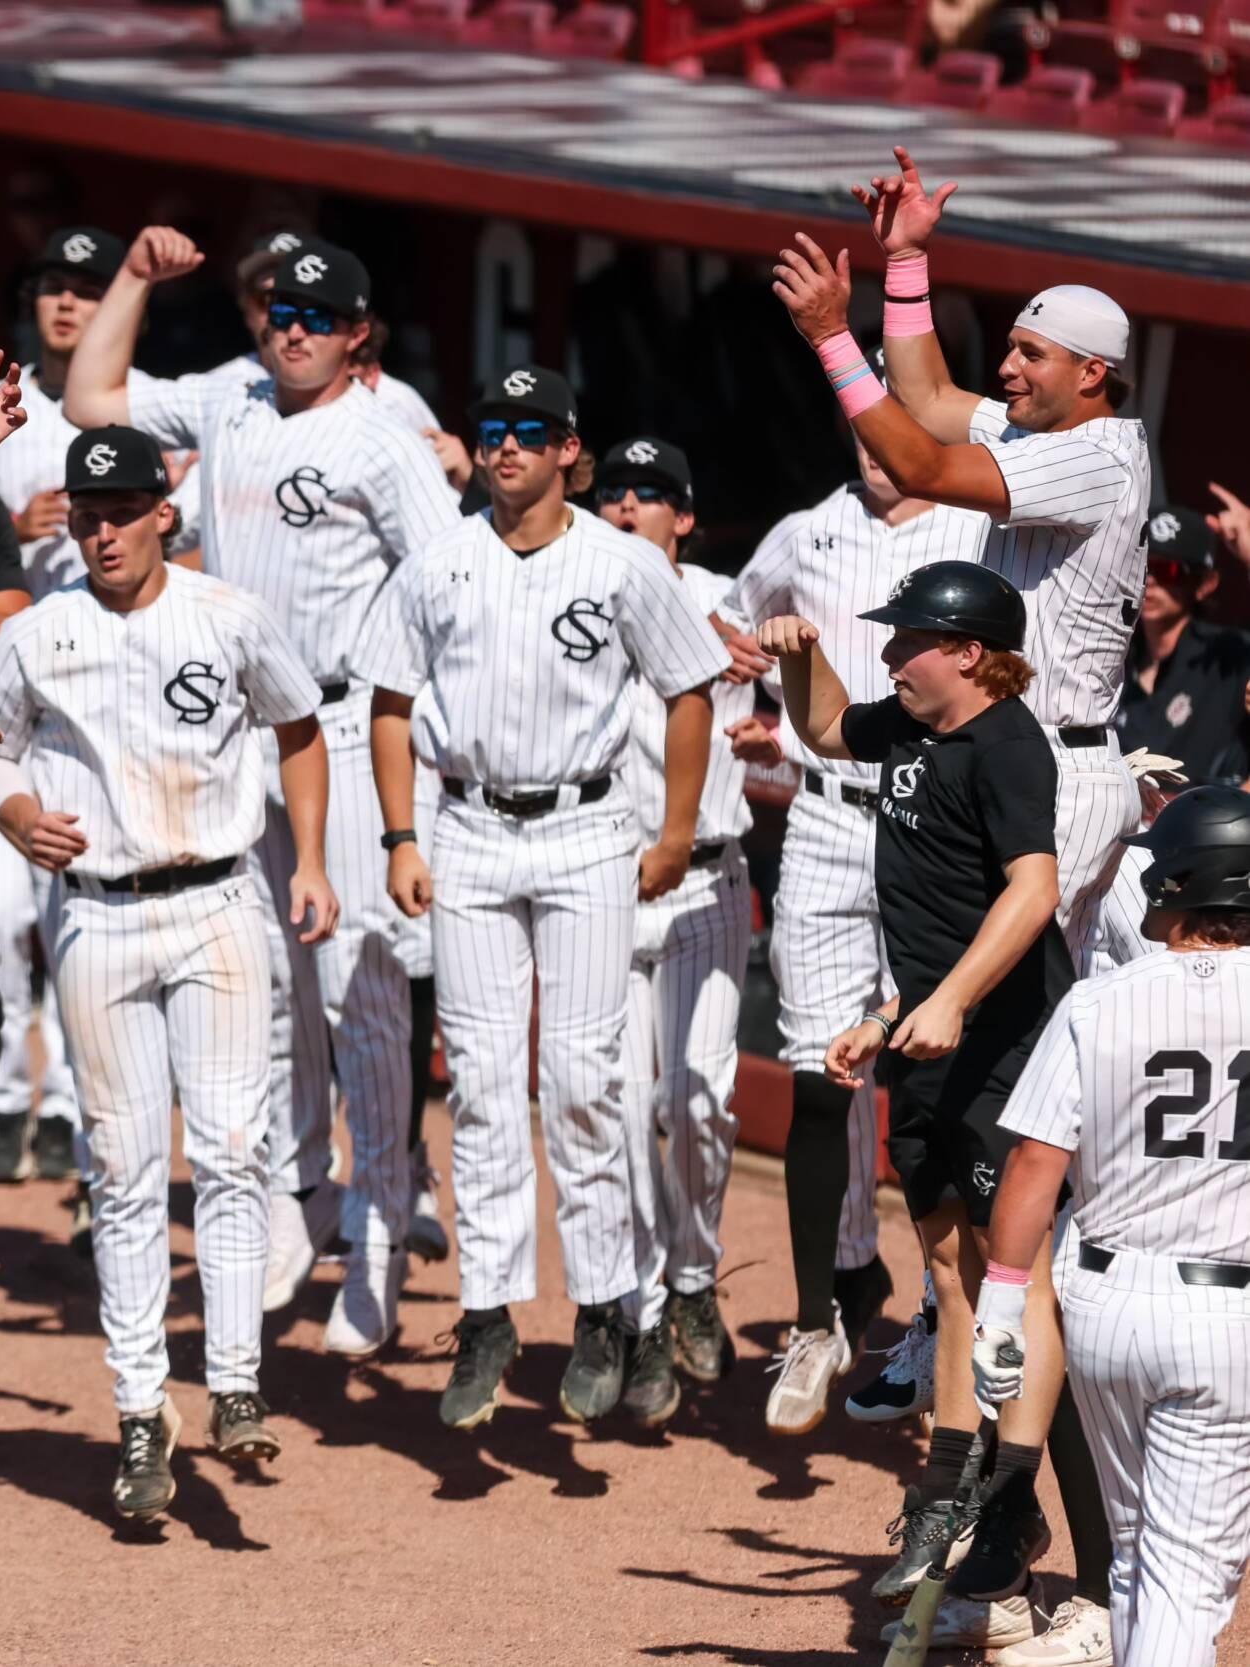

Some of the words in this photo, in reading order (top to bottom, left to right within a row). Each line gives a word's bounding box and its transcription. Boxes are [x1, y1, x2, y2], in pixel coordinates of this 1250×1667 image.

[275, 466, 335, 527] SC
[551, 598, 613, 662] SC
[163, 660, 226, 725] SC
[1144, 1049, 1250, 1161] 21
